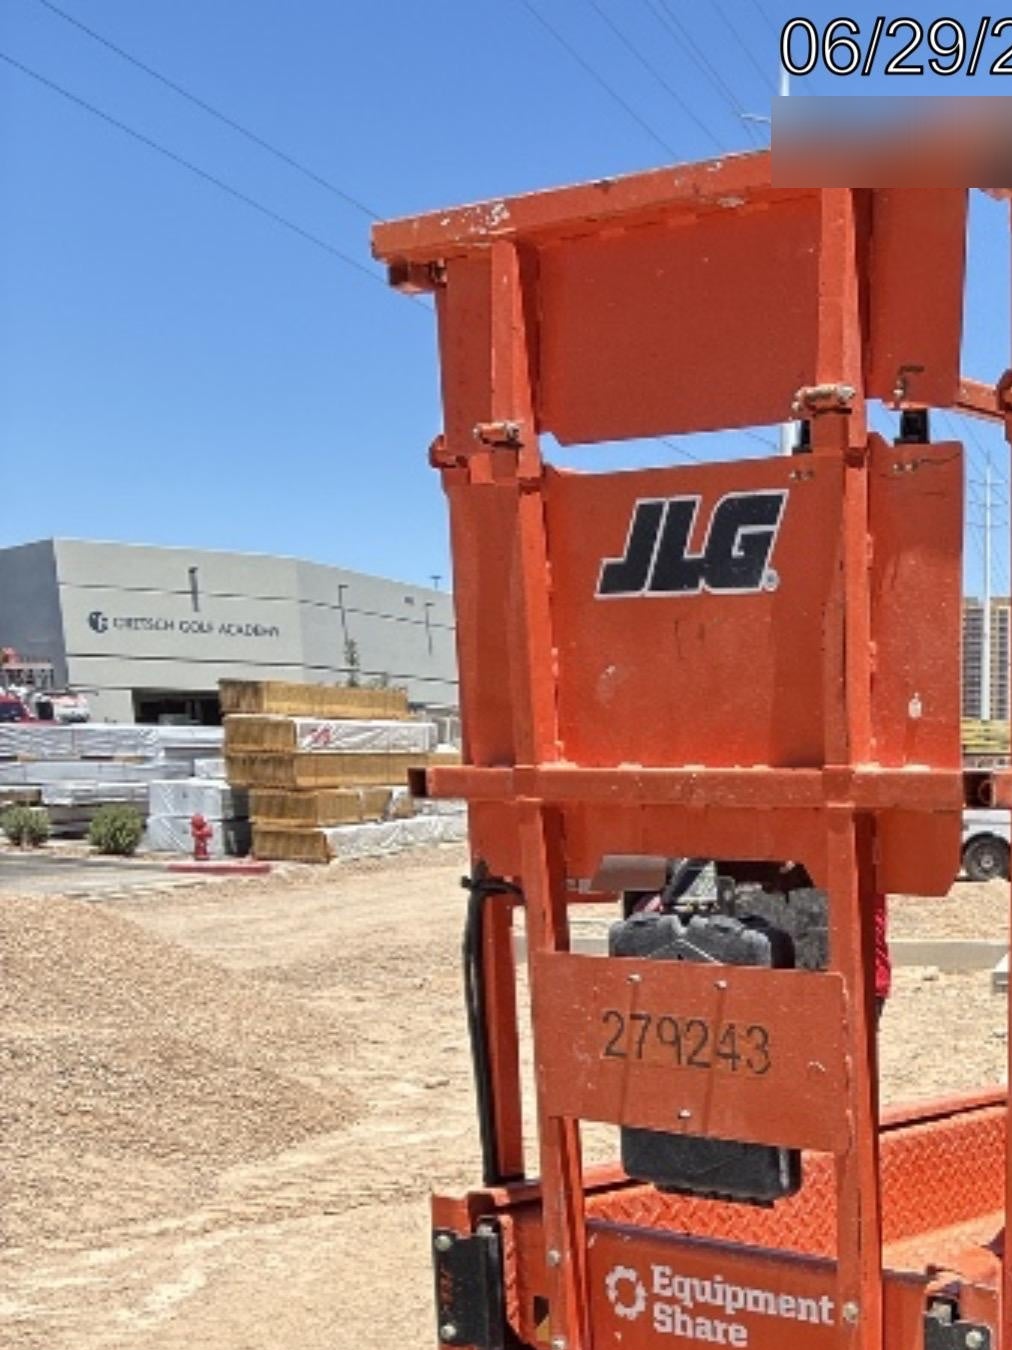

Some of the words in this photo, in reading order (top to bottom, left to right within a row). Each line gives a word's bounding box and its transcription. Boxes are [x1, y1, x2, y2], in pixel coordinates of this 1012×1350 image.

[594, 489, 789, 598] JLG
[602, 1009, 772, 1076] 279243
[651, 1264, 835, 1325] Equipment
[653, 1301, 748, 1348] Share
